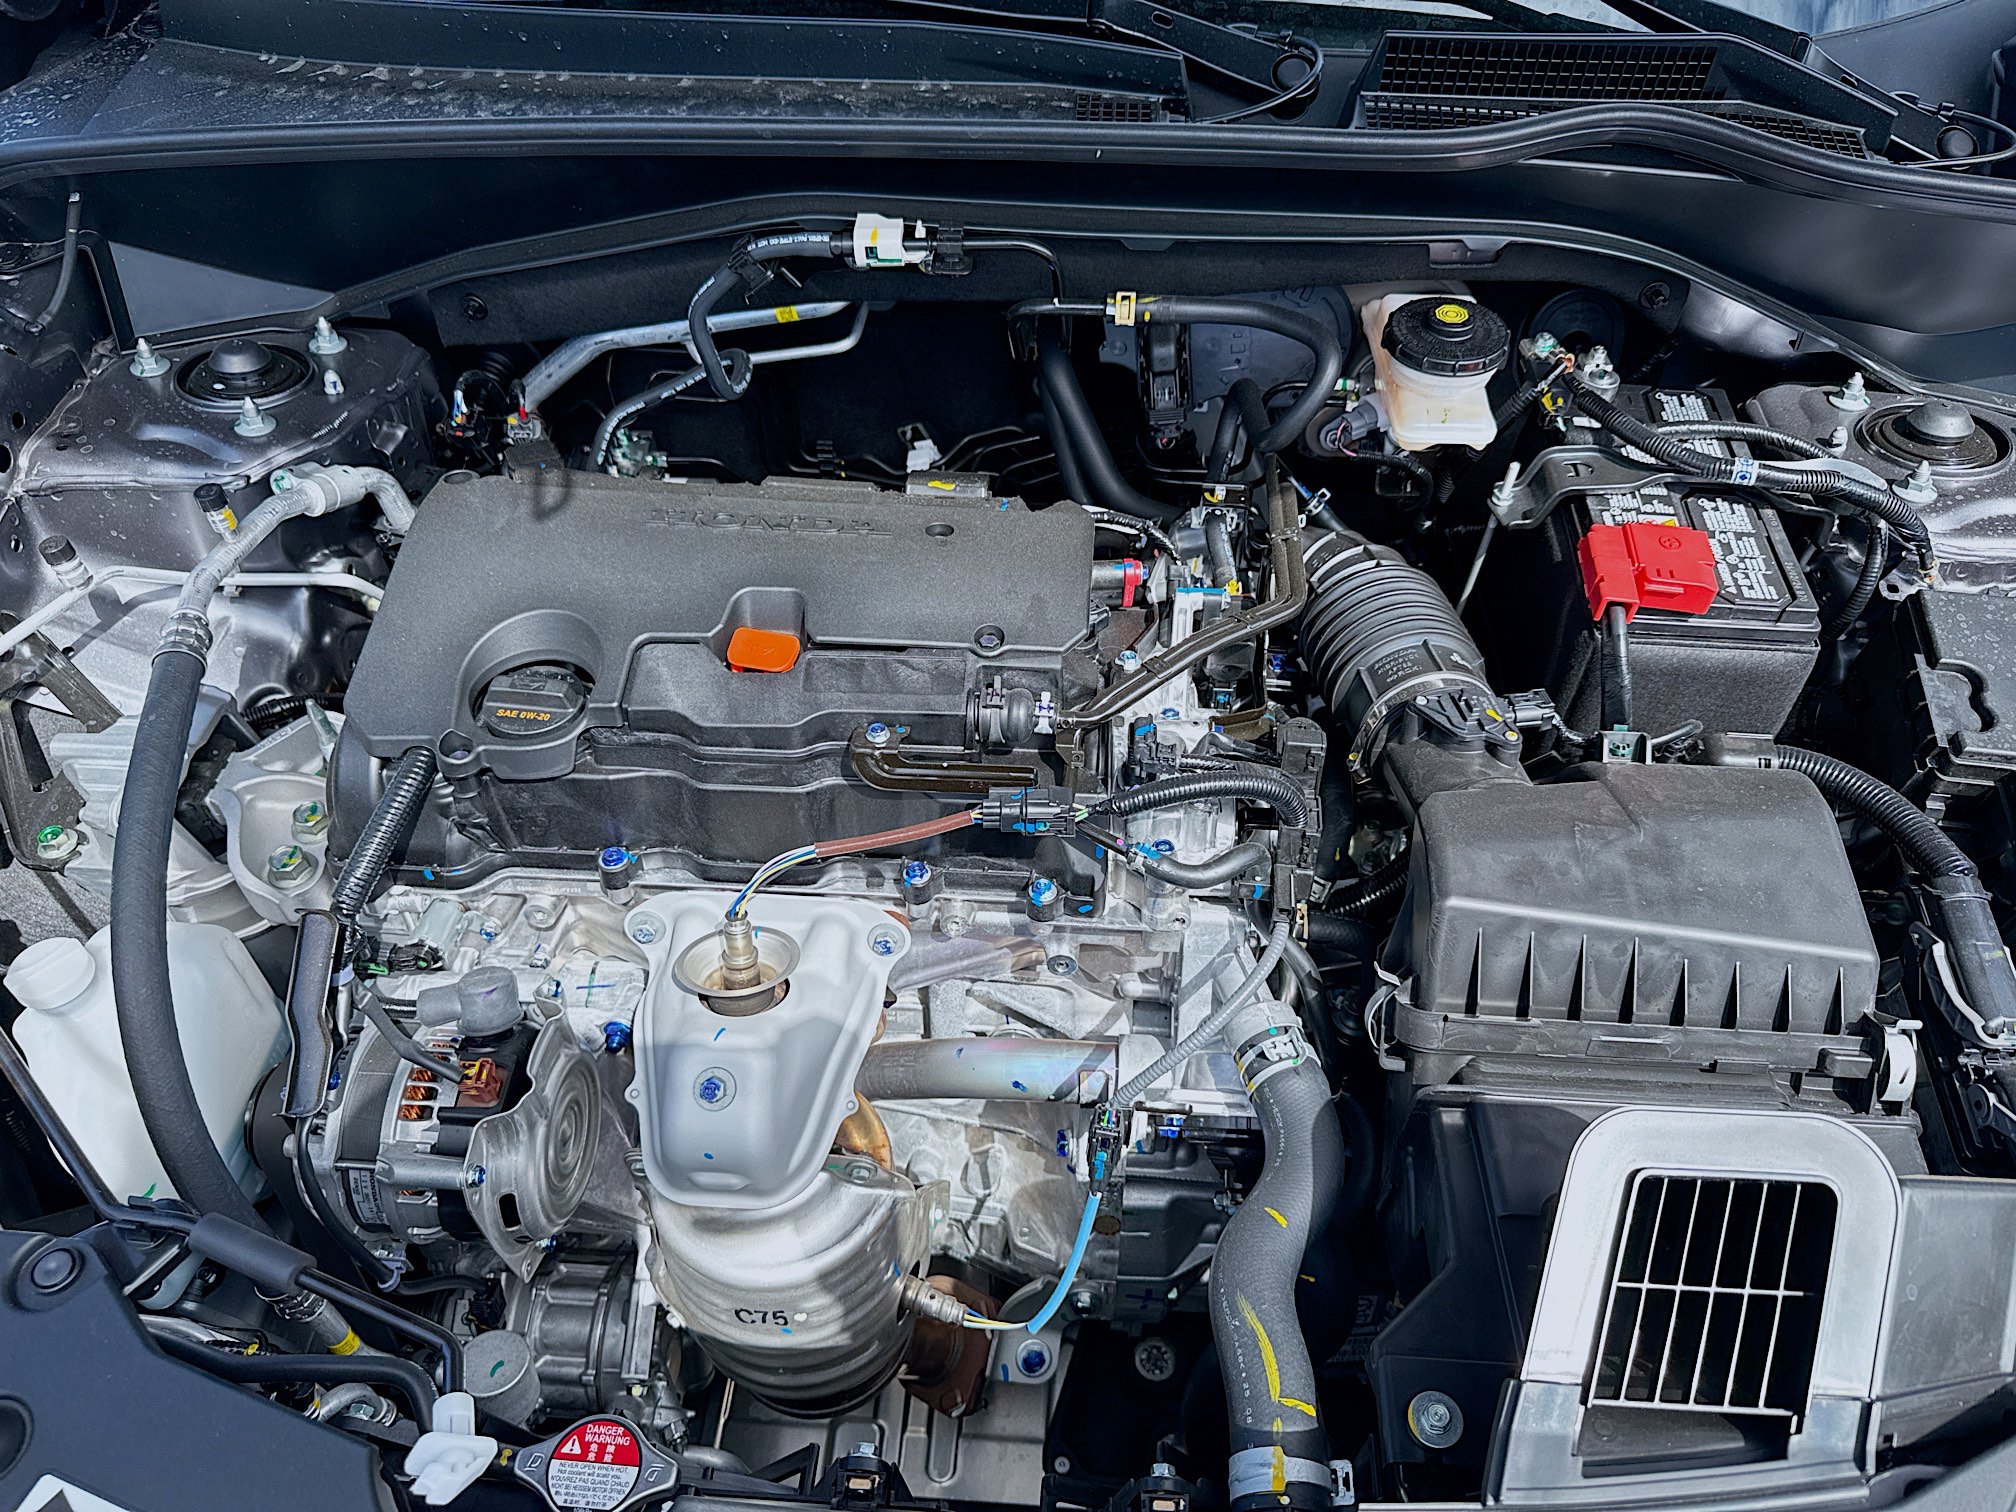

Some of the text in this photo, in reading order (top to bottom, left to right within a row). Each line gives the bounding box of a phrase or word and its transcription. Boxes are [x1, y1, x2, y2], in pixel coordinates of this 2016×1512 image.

[644, 509, 893, 537] HONDA
[496, 709, 551, 722] SAE 0W-20
[734, 1308, 789, 1326] C75
[586, 1423, 625, 1436] DANGER
[585, 1433, 631, 1446] WARNUNG
